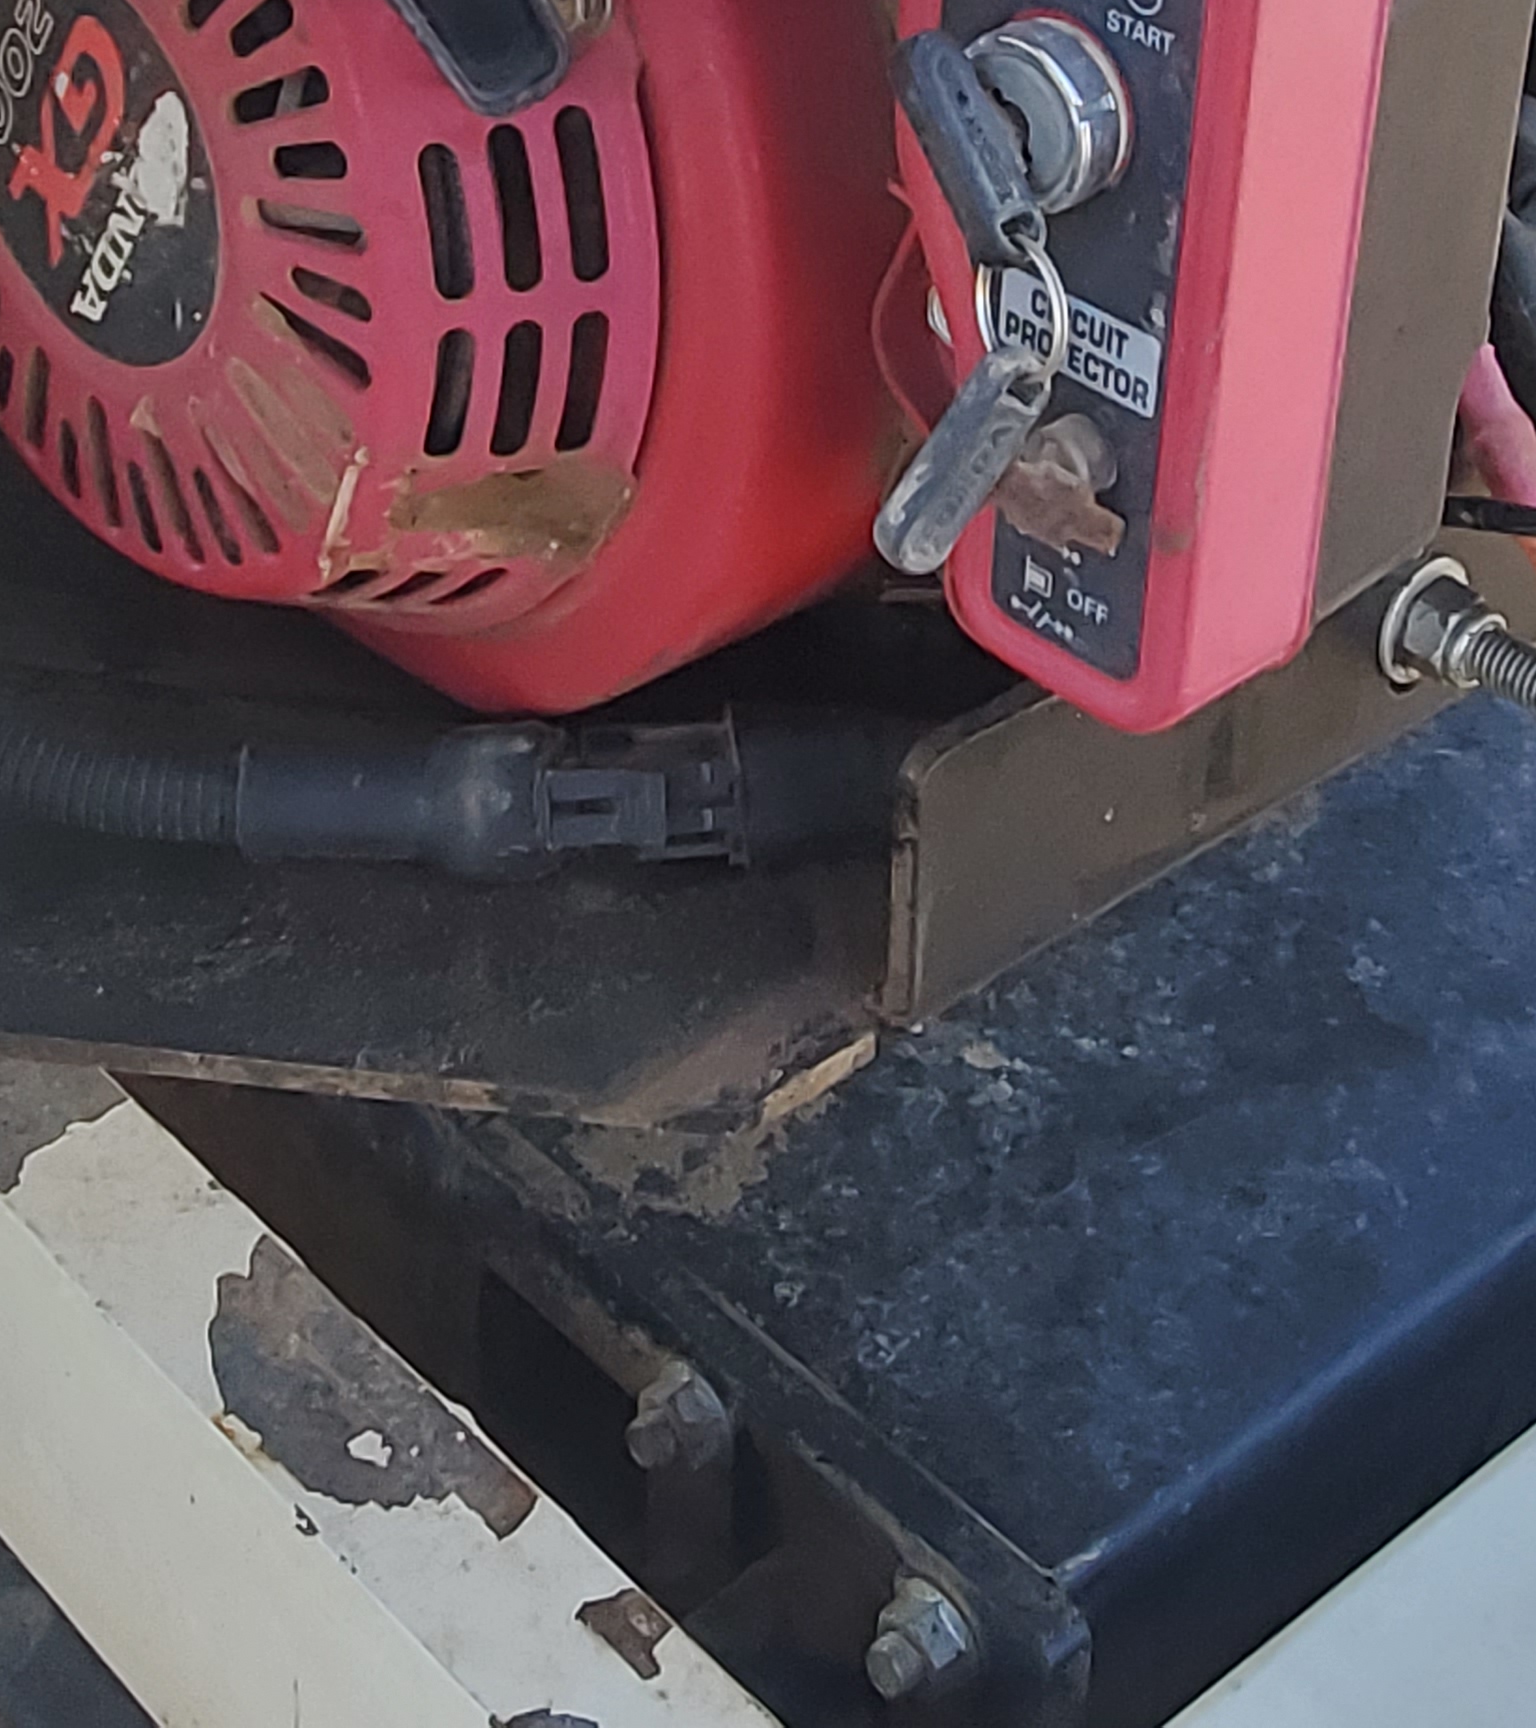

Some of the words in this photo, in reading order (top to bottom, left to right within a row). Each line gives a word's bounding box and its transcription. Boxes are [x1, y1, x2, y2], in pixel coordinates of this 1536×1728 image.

[1106, 8, 1175, 55] START
[7, 15, 125, 268] GX
[1005, 309, 1150, 410] PROECTOR
[1066, 588, 1109, 625] OFF
